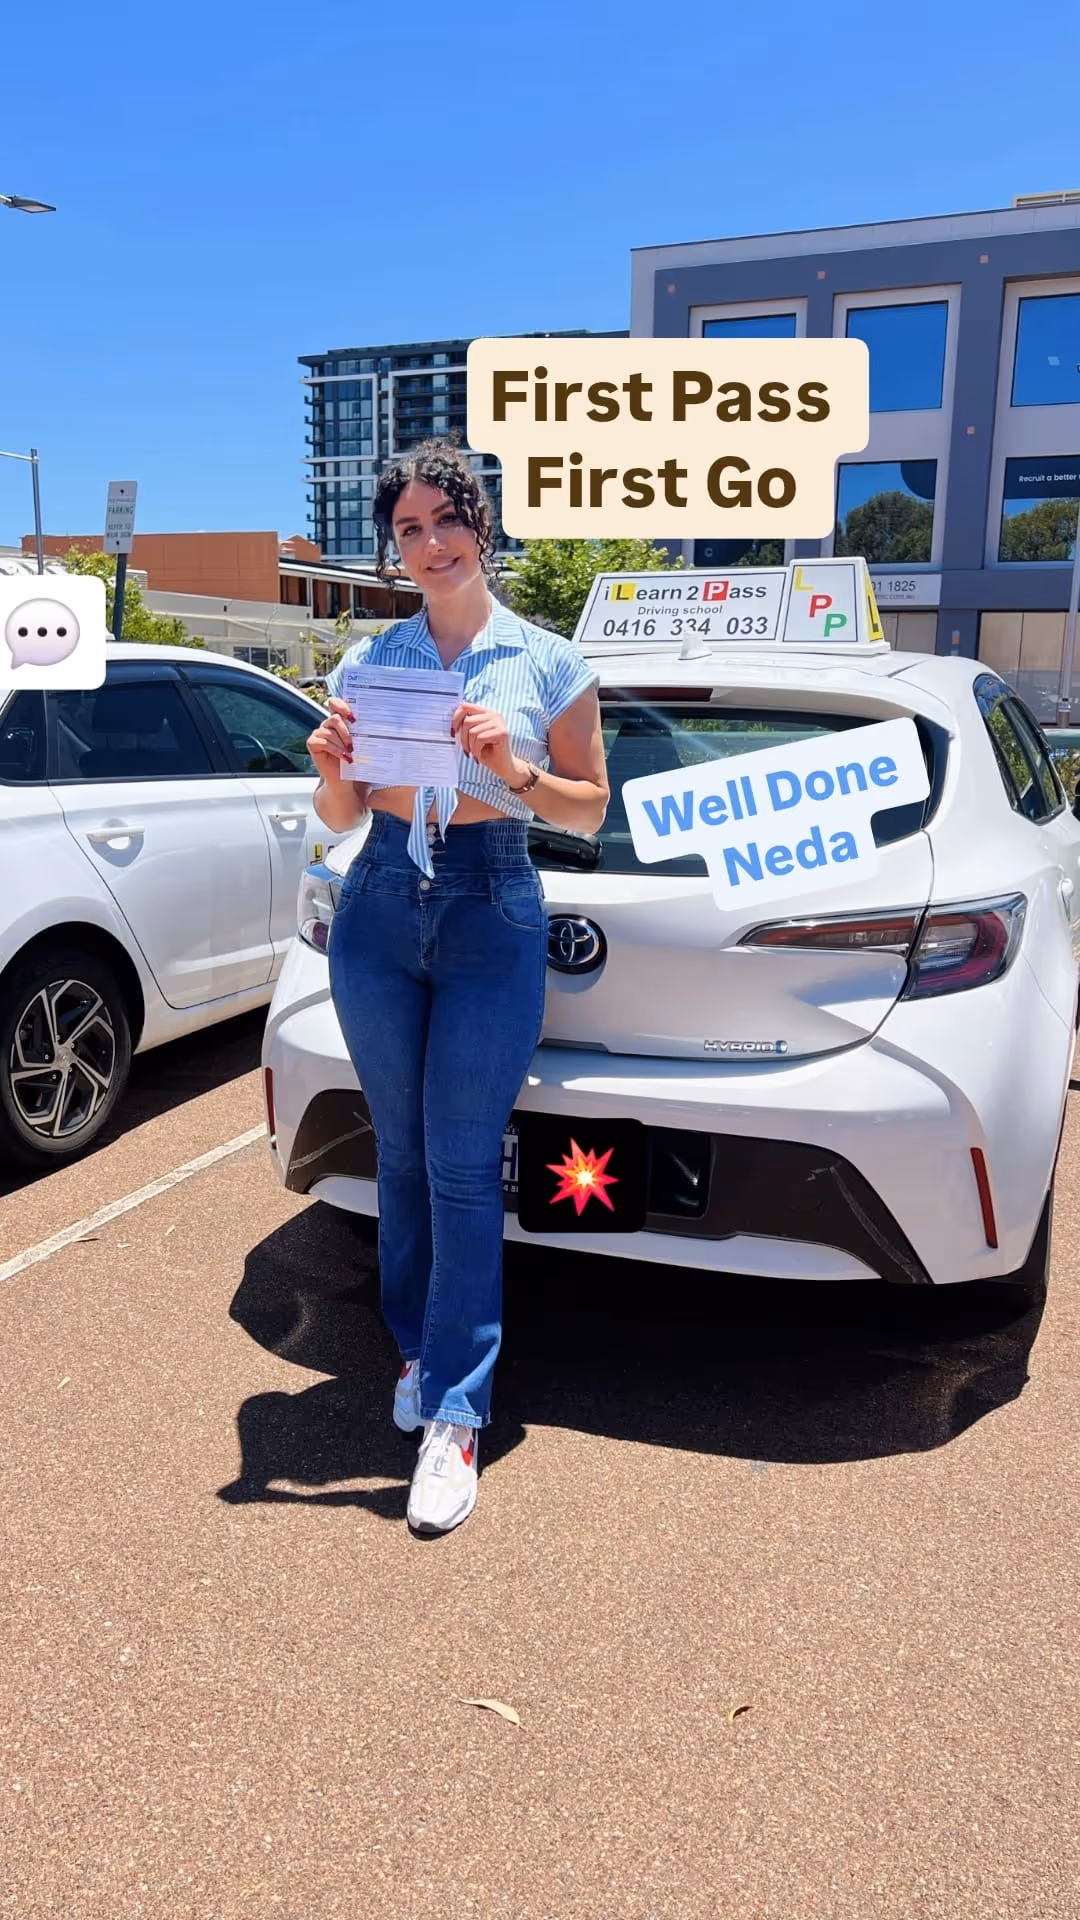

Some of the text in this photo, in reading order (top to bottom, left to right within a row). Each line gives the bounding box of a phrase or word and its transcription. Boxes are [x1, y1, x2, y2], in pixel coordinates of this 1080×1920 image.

[1018, 474, 1046, 482] Recruit
[108, 505, 134, 514] PARKING
[794, 565, 814, 591] L
[888, 580, 917, 592] 1825
[637, 604, 724, 617] Driving school
[808, 594, 833, 618] P
[602, 616, 769, 637] 0416 334 033
[823, 613, 848, 638] P
[703, 1039, 775, 1053] HYBRID
